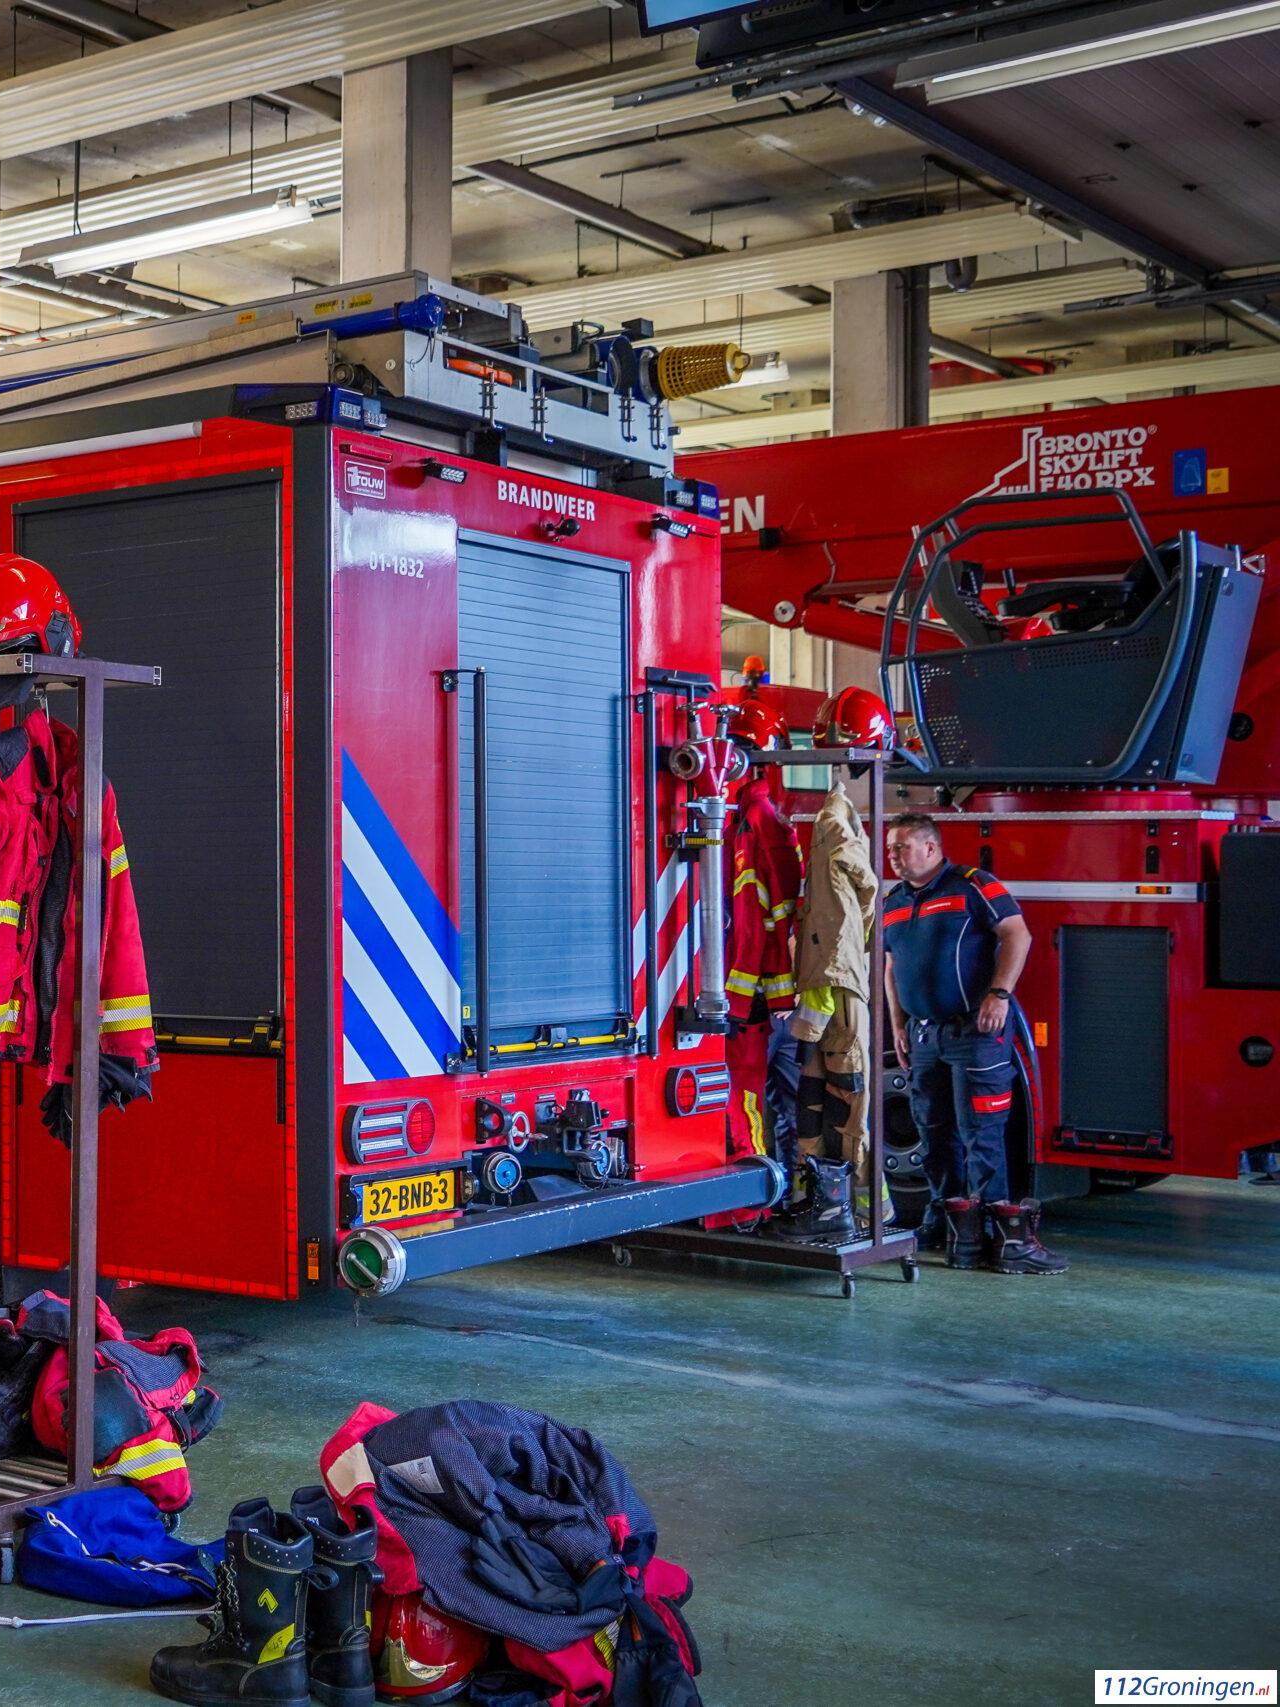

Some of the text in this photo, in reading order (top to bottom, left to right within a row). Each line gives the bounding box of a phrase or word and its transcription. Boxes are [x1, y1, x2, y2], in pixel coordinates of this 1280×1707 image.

[1039, 426, 1147, 456] BRONTO
[1039, 447, 1143, 476] SKYLIFT
[497, 479, 596, 521] BRANDWEER
[369, 552, 424, 578] 01-1832
[369, 1178, 448, 1216] 32-BNB-3
